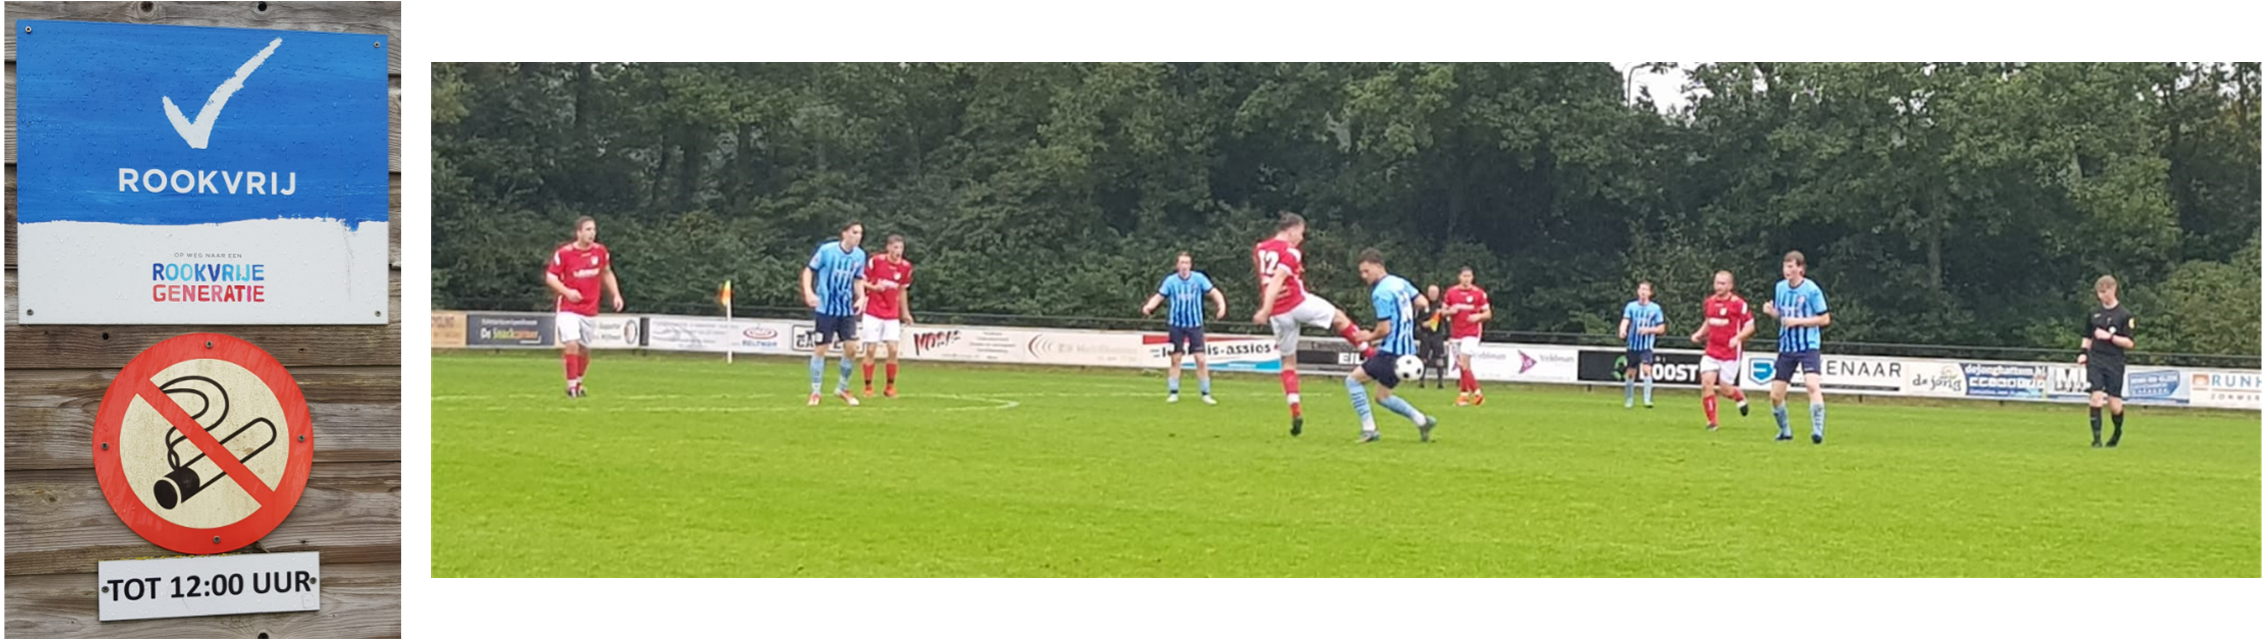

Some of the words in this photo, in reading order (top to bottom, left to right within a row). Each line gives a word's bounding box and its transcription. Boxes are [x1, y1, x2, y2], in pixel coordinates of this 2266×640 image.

[118, 167, 297, 196] ROOKVRIJ
[152, 263, 264, 282] ROOKVRIJE
[1258, 250, 1279, 274] 12
[153, 284, 265, 302] GENERATIE
[107, 579, 162, 602] TOT
[169, 575, 244, 599] 12:00
[252, 570, 313, 595] UUR
